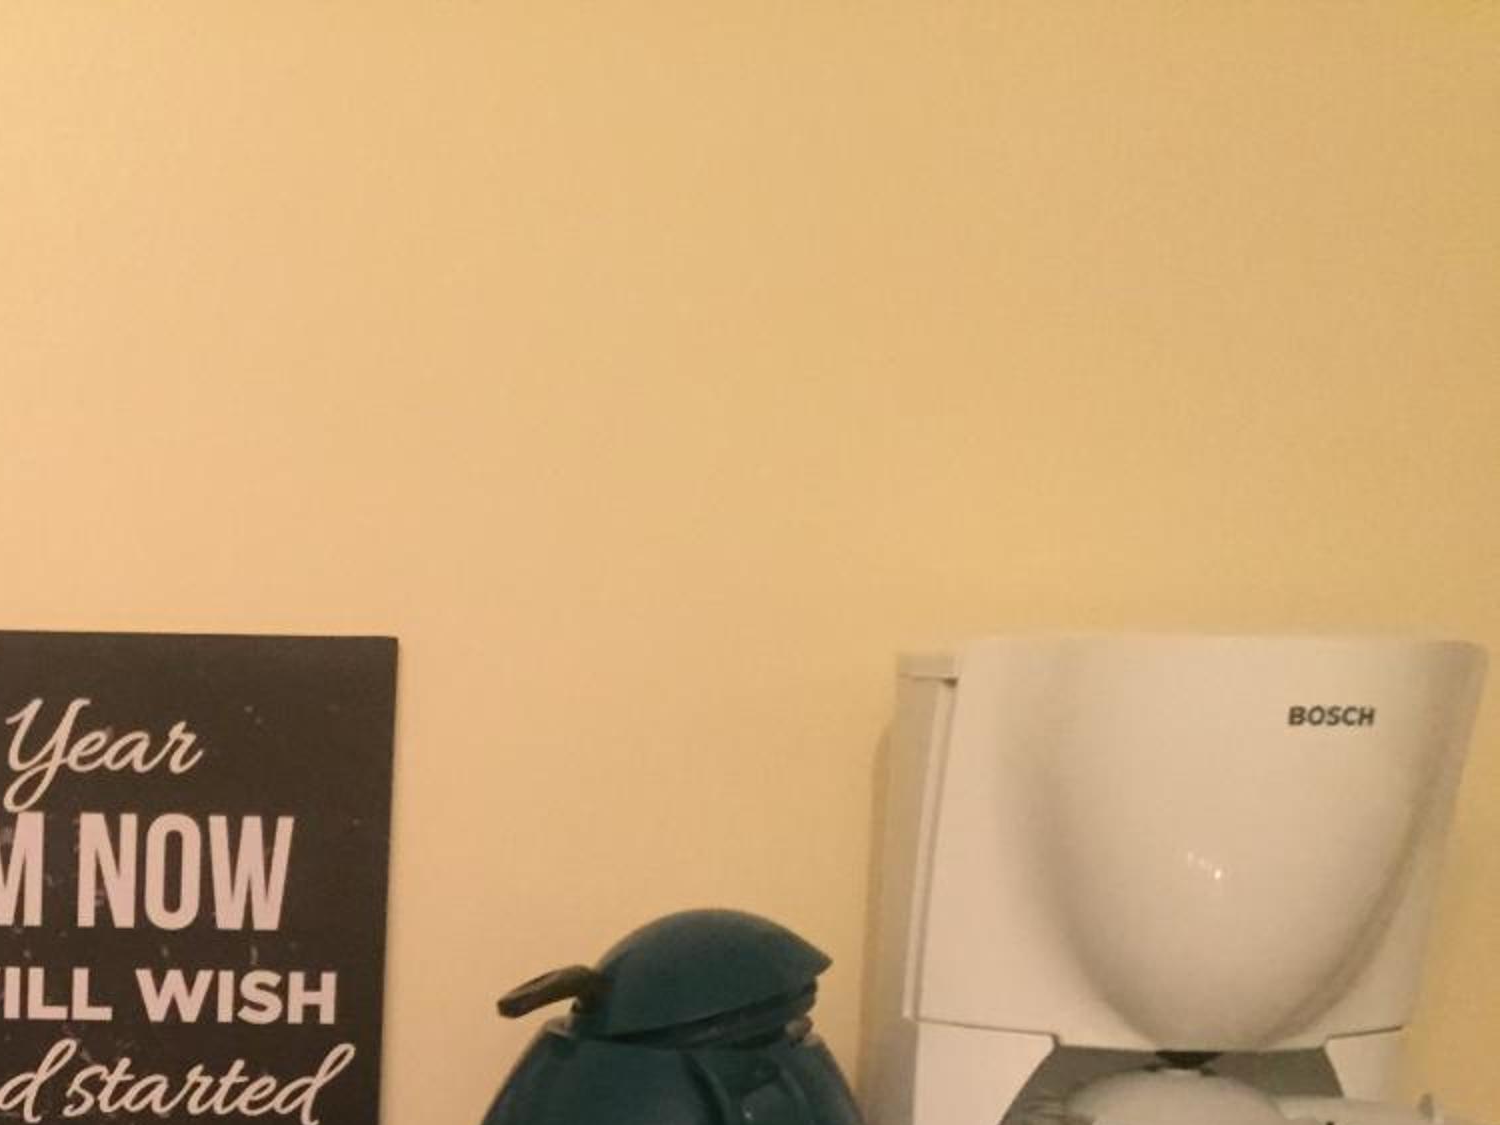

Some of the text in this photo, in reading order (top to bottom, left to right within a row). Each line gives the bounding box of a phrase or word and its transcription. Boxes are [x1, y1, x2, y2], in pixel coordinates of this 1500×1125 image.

[3, 697, 203, 812] Year
[1288, 705, 1376, 727] BOSCH
[77, 812, 295, 931] NOW
[136, 968, 337, 1025] WISH
